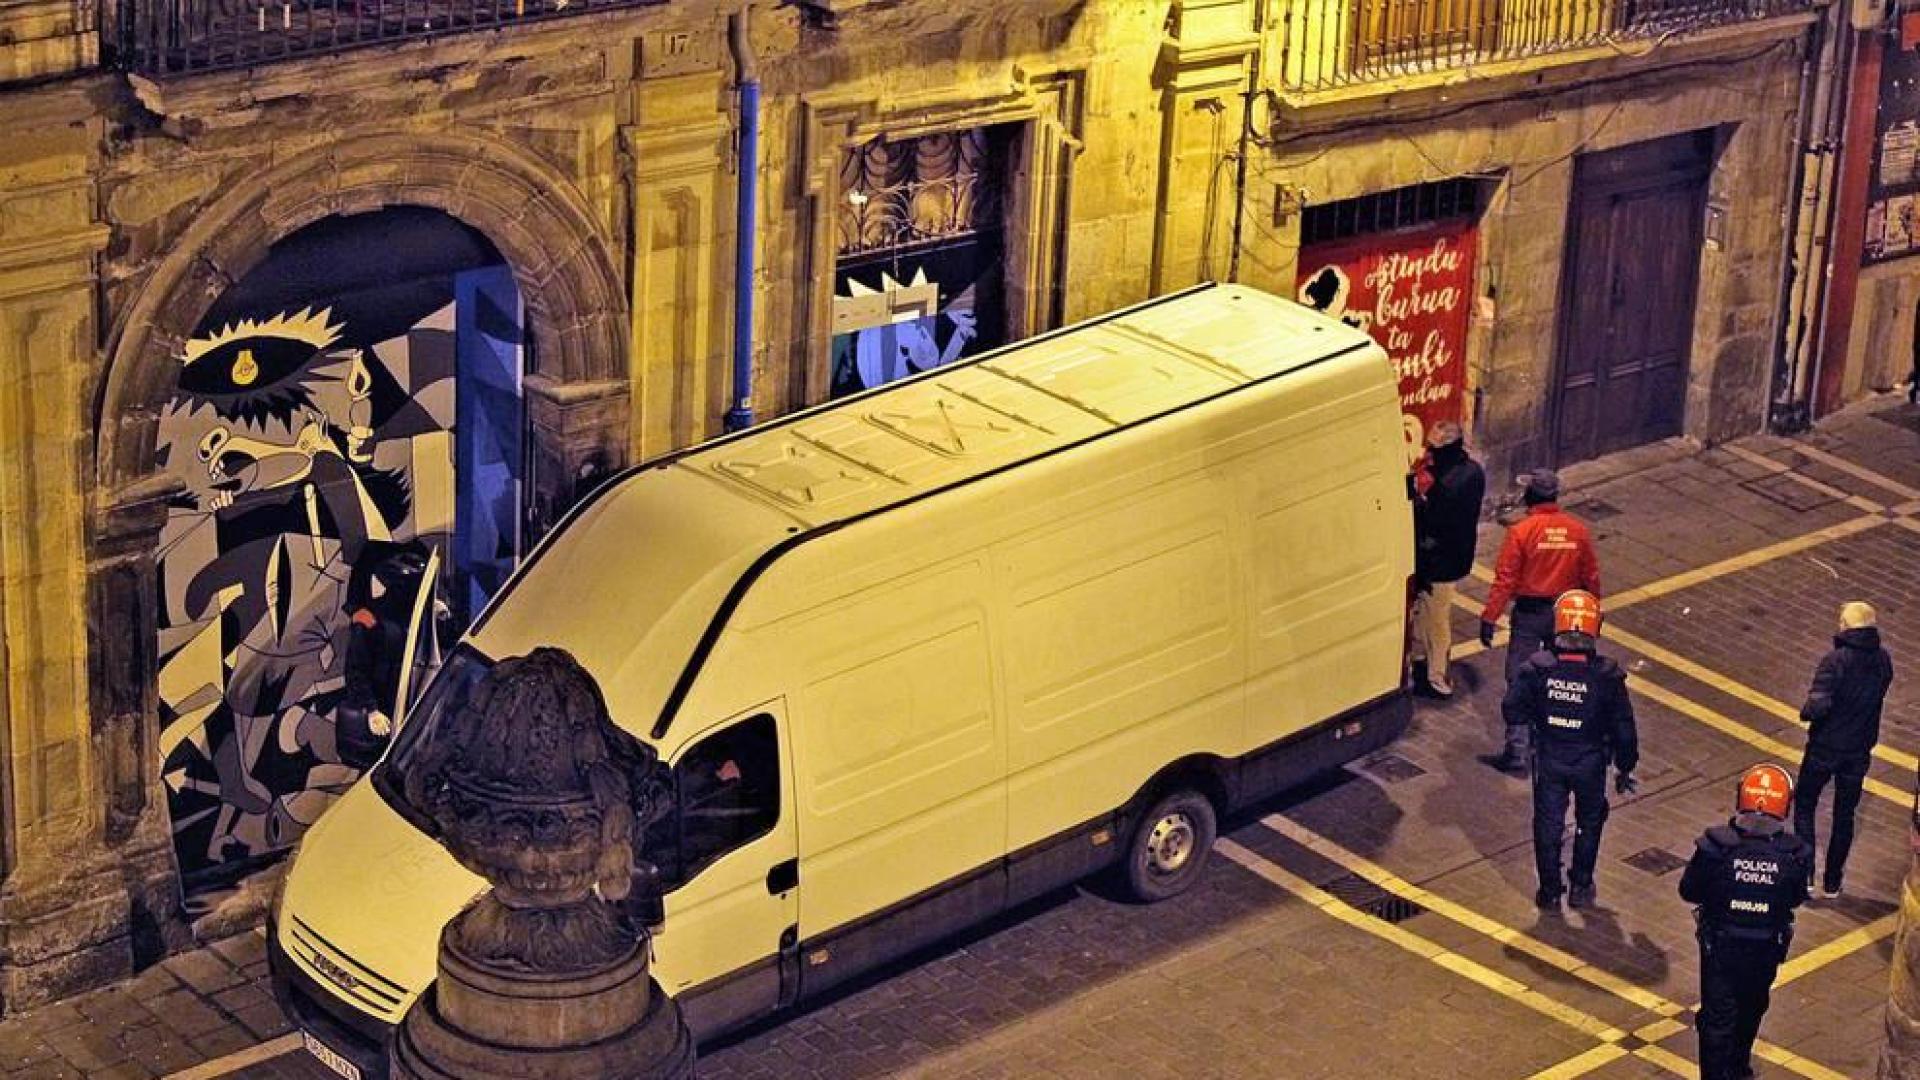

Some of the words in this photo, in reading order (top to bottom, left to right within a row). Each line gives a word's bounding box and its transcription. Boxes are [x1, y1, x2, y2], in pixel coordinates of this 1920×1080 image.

[670, 33, 688, 55] 17
[1376, 281, 1461, 326] burua
[1388, 325, 1413, 350] ta
[1547, 678, 1587, 693] POLICIA
[1548, 689, 1583, 704] FORAL
[1733, 858, 1779, 873] POLICIA
[1735, 870, 1775, 885] FORAL
